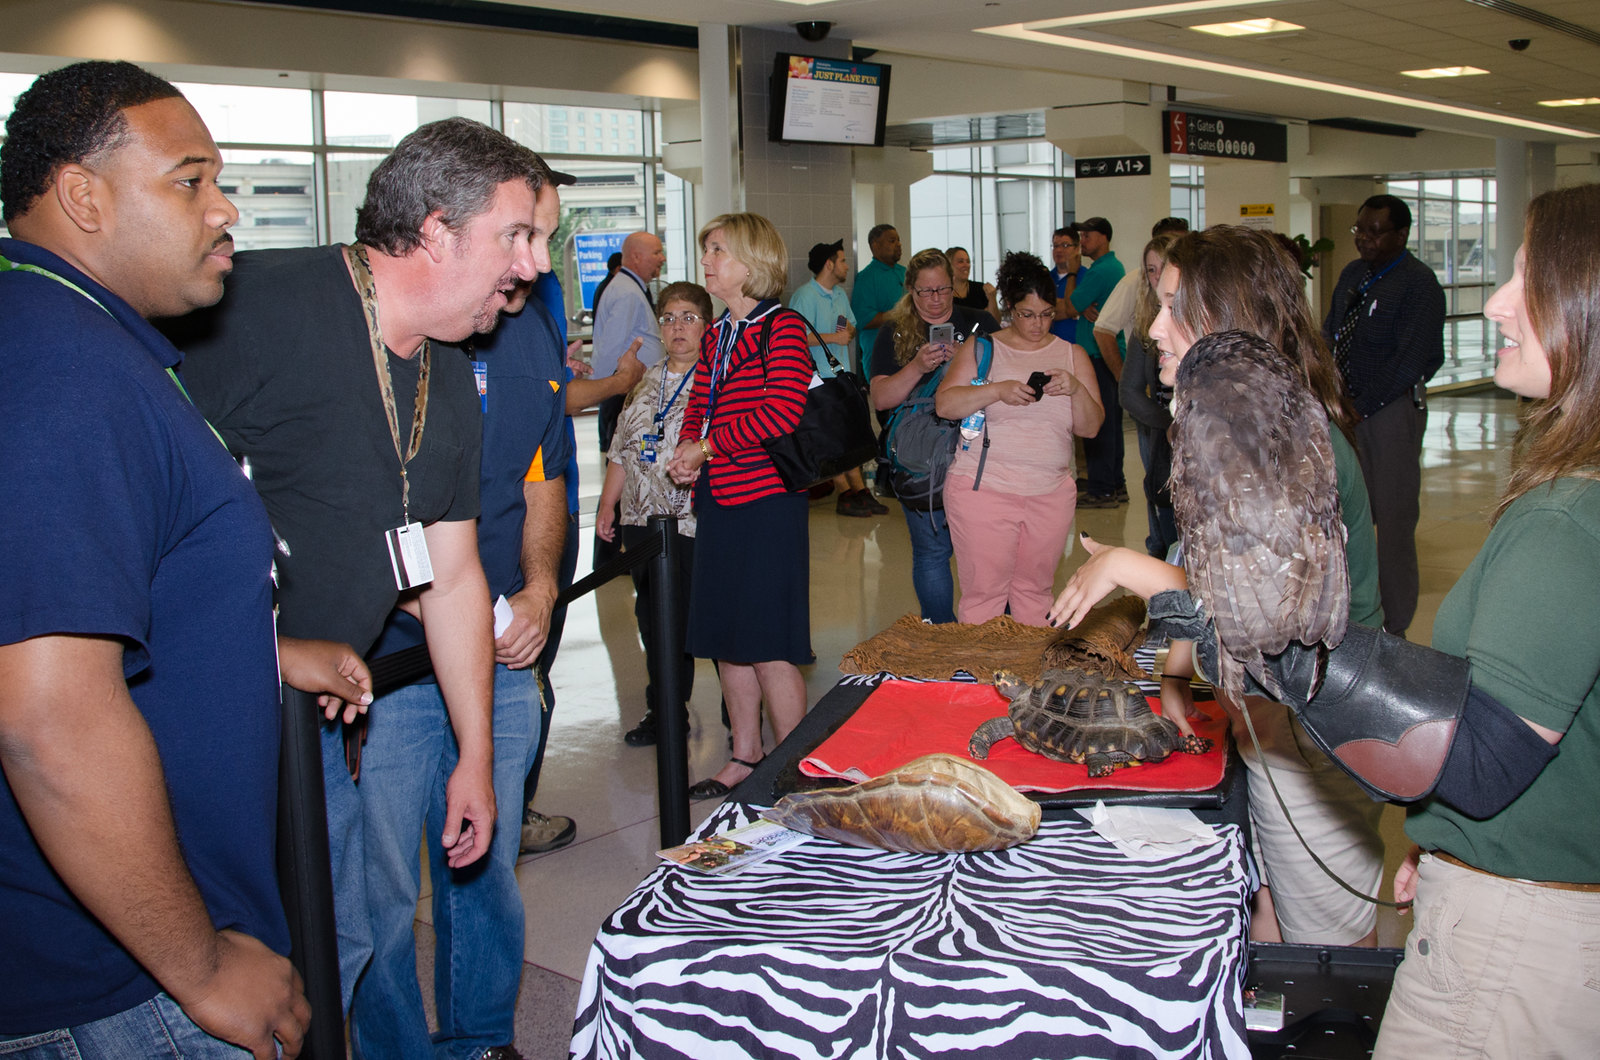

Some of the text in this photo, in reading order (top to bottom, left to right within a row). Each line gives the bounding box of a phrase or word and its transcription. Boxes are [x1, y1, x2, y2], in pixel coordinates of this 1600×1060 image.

[814, 70, 878, 85] JUST PLANE FUN
[1197, 119, 1216, 132] Gates
[1197, 138, 1216, 151] Gates
[1115, 159, 1131, 173] A1
[578, 239, 608, 248] Terminals
[579, 251, 603, 261] Parking
